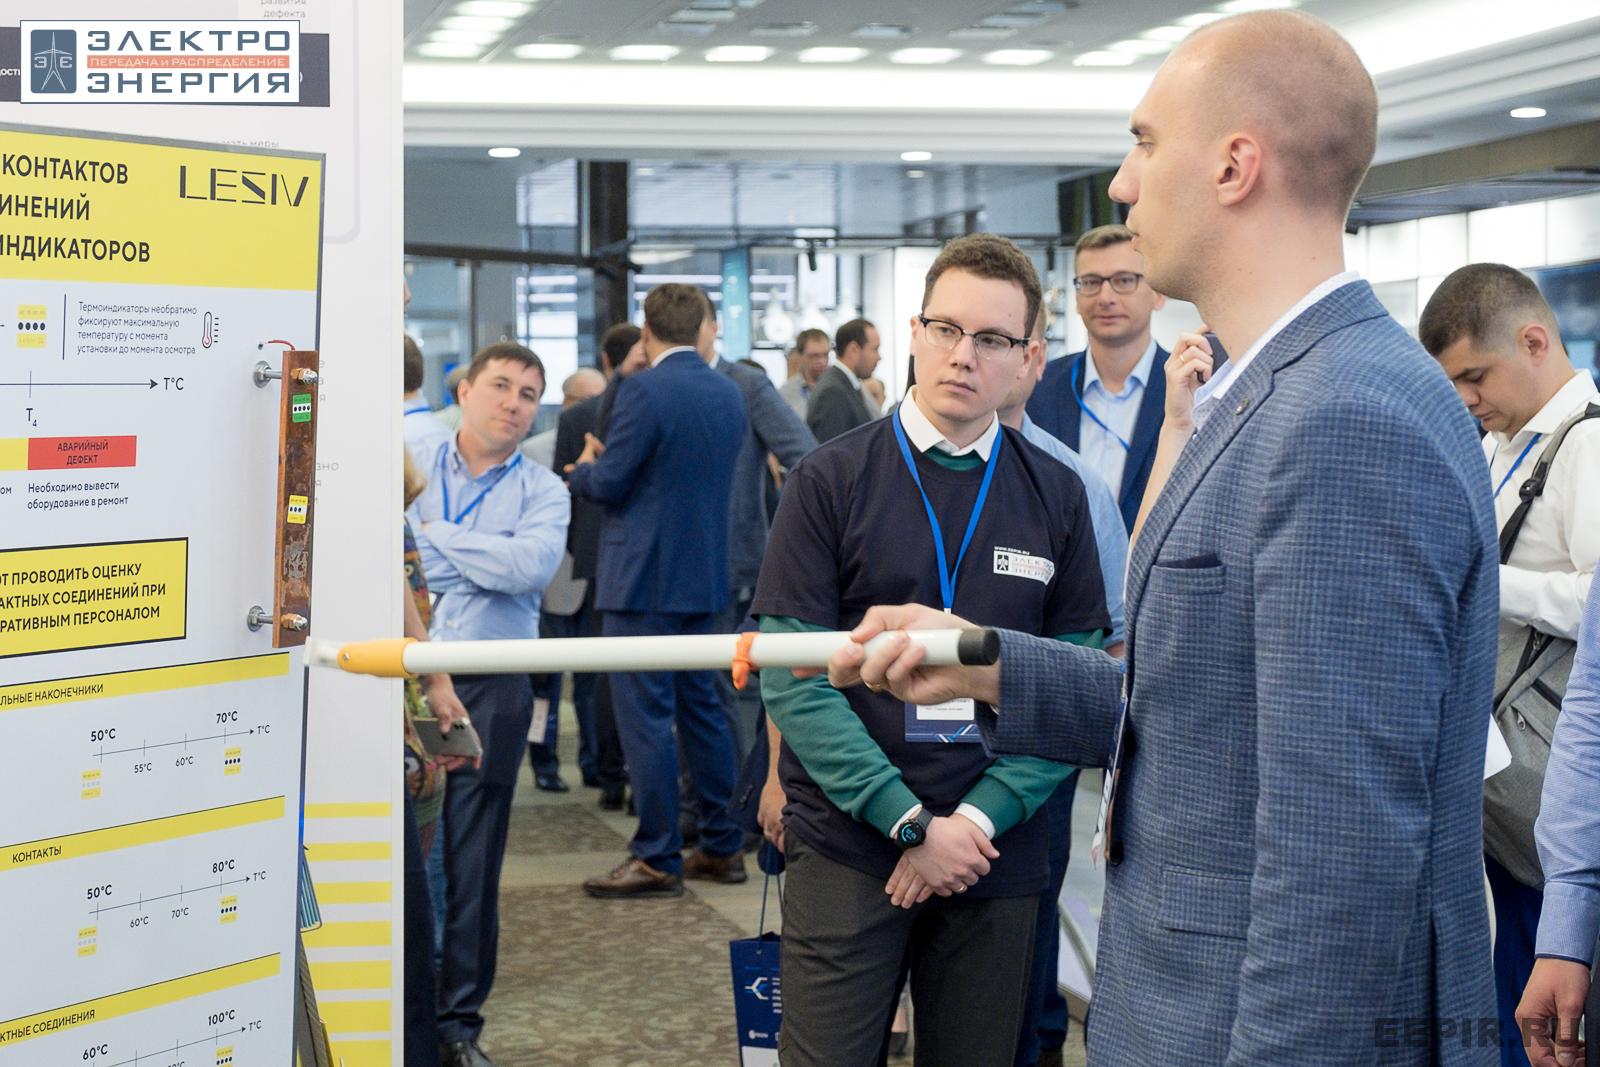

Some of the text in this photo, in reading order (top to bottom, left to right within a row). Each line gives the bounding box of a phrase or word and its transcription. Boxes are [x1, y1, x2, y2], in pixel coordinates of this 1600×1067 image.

[2, 154, 128, 184] КОНТАКТОВ
[180, 165, 310, 207] LESIV
[79, 301, 197, 315] Термоиндикаторы необратимо
[78, 316, 179, 329] фиксируют максимальную
[77, 331, 128, 341] температуру
[77, 345, 117, 355] установки
[119, 346, 128, 354] до
[164, 347, 196, 355] осмотра
[57, 439, 108, 451] АВАРИЙНЫЙ
[66, 455, 98, 465] ДЕФЕКТ
[28, 481, 119, 493] Необходимо вывести
[27, 498, 89, 510] оборудование
[98, 496, 128, 508] ремонт
[12, 568, 89, 585] ПРОВОДИТЬ
[92, 563, 142, 580] ОЦЕНКУ
[0, 582, 166, 609] АКТНЫХ СОЕДИНЕНИЙ ПРИ
[0, 606, 160, 632] РАТИВНЫМ ПЕРСОНАЛОМ
[35, 684, 103, 701] НАКОНЕЧНИКИ
[216, 711, 238, 724] 70°C
[90, 728, 116, 742] 50°C
[134, 762, 152, 774] 55°C
[175, 755, 194, 767] 60°C
[12, 845, 62, 864] КОНТАКТЫ
[212, 859, 235, 874] 80°C
[87, 884, 112, 900] 50°C
[171, 907, 189, 919] 70°C
[130, 916, 149, 928] 60°C
[33, 1009, 95, 1033] СОЕДИНЕНИЯ
[208, 1009, 235, 1026] 100°C
[82, 1044, 108, 1061] 60°C
